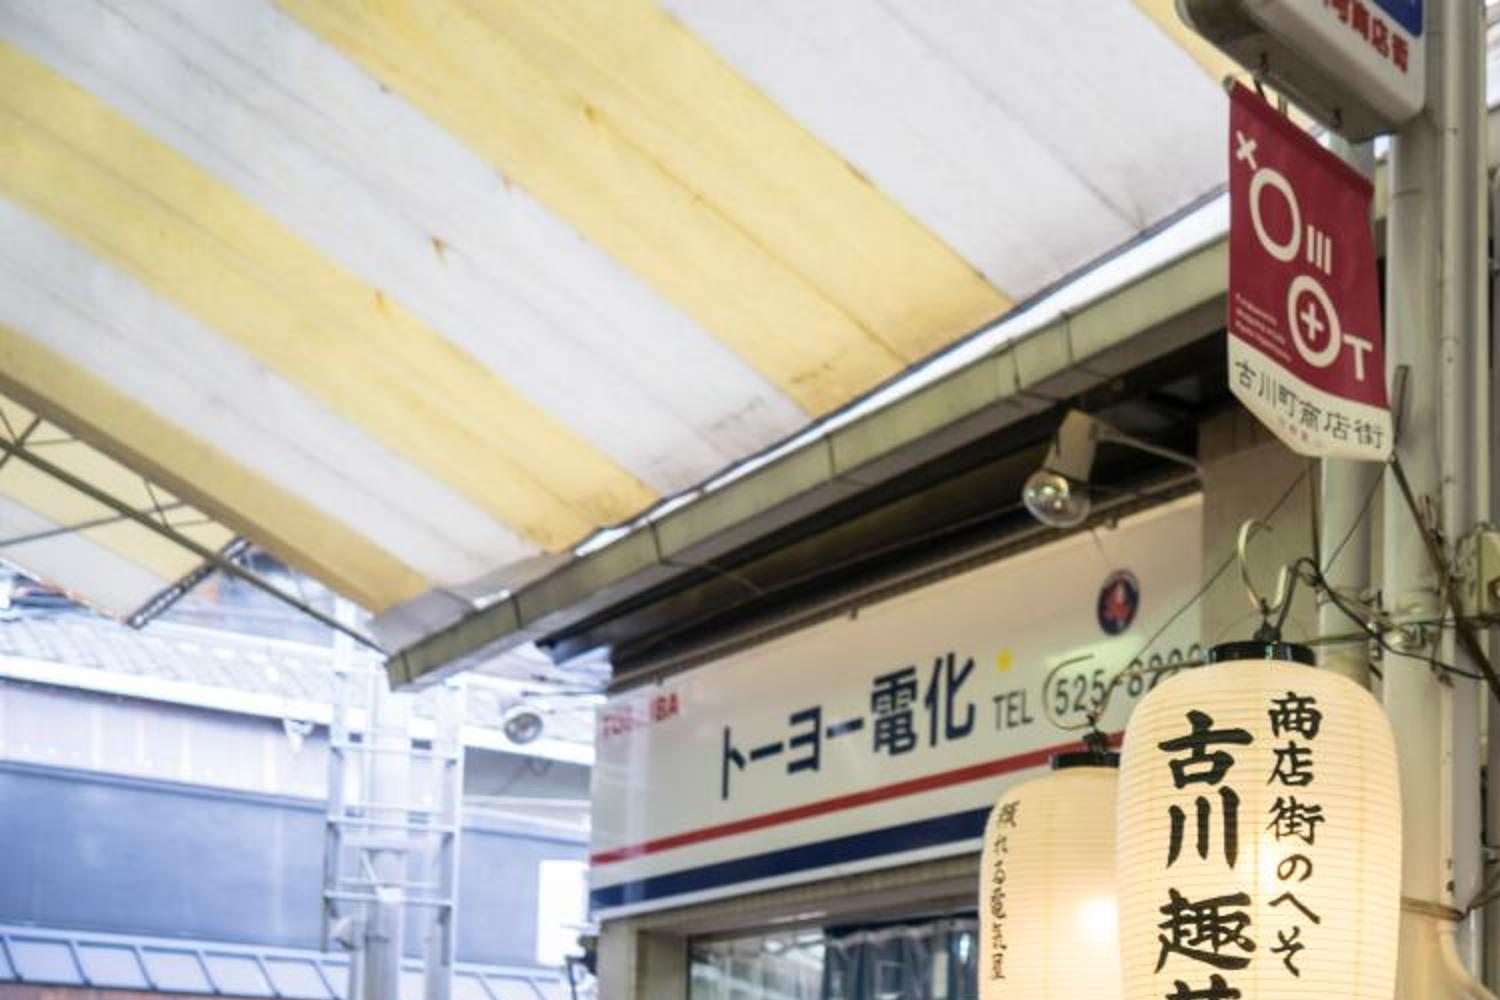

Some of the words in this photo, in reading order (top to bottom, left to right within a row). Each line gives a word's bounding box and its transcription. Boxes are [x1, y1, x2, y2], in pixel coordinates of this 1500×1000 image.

[1234, 358, 1385, 449] 古川町商店街
[722, 651, 977, 801] トーヨー電化
[992, 686, 1034, 731] TEL
[1265, 691, 1326, 978] 商店街のへそ
